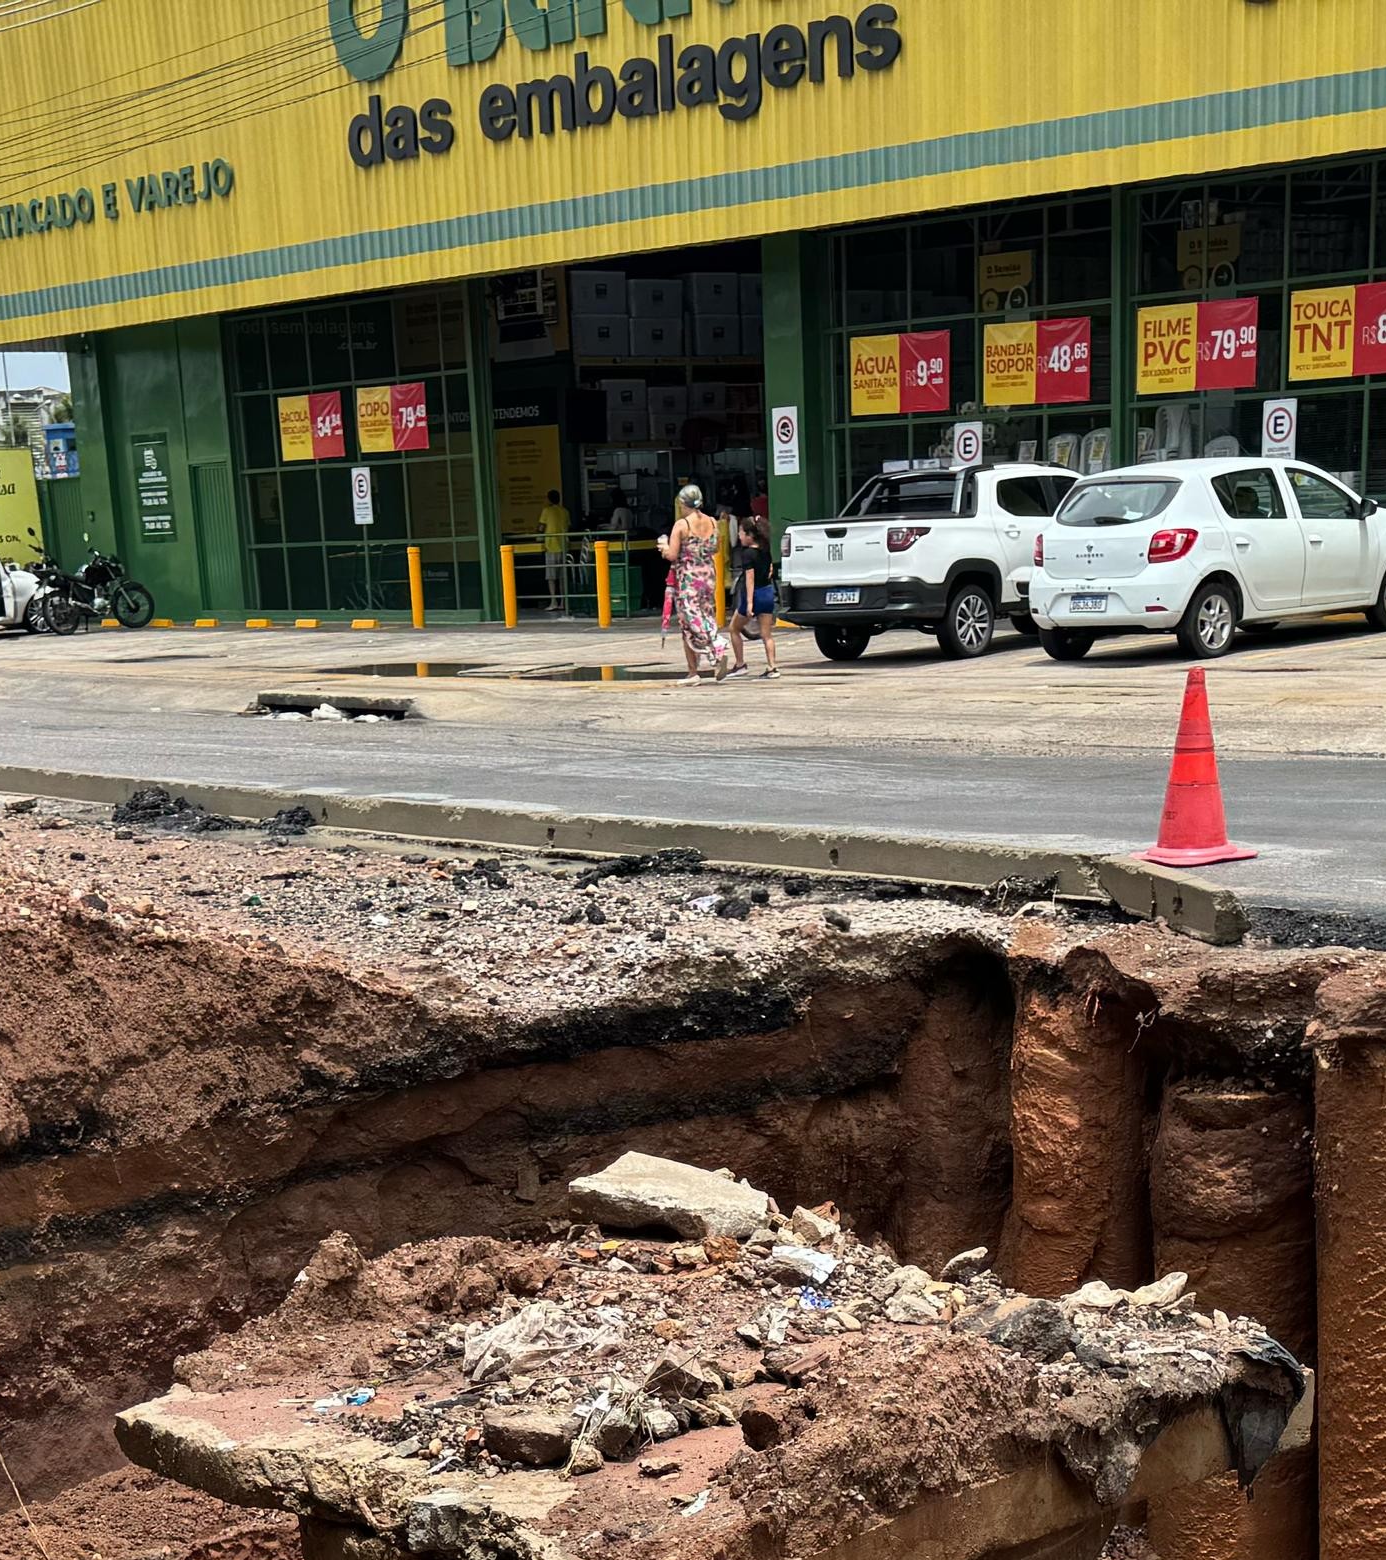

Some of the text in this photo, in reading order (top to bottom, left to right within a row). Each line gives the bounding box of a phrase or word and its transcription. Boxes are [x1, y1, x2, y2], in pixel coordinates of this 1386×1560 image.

[348, 94, 454, 169] das
[479, 3, 901, 139] embalagens
[102, 182, 119, 219] E
[125, 157, 235, 213] VAREJO
[1294, 299, 1352, 321] TOUCA
[1143, 317, 1192, 338] FILME
[1294, 320, 1352, 353] TNT
[986, 342, 1034, 358] BANDEJA
[1144, 338, 1191, 367] PVC
[1211, 326, 1256, 360] 79,90
[854, 354, 897, 376] ÁGUA
[917, 358, 943, 386] 9,90
[986, 358, 1034, 374] ISOPOR
[359, 402, 389, 417] COPO
[493, 406, 540, 420] TENDEMOS
[1274, 416, 1285, 434] E
[963, 437, 973, 454] E
[357, 479, 365, 493] E
[828, 544, 844, 561] FIAT
